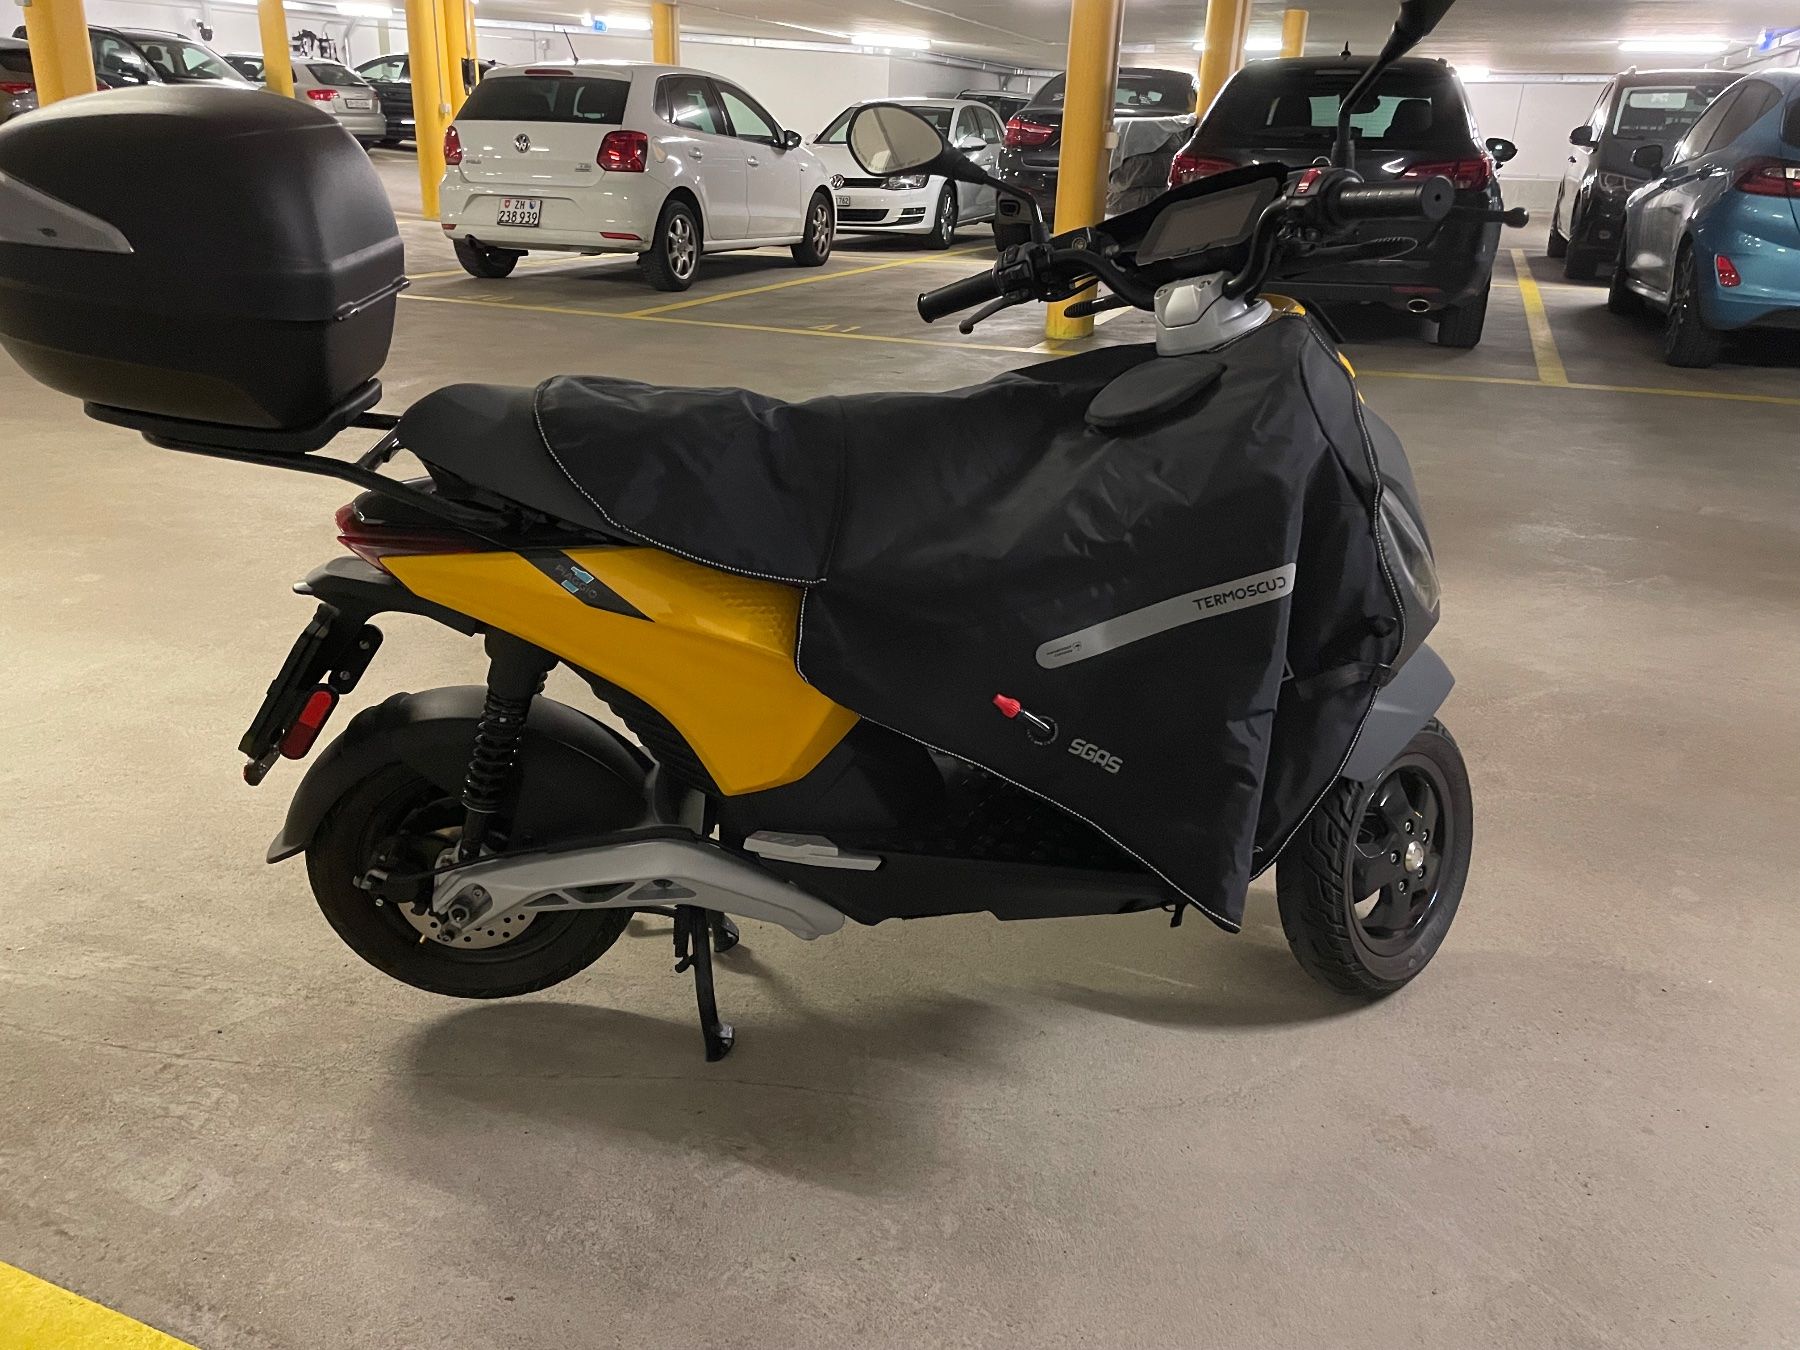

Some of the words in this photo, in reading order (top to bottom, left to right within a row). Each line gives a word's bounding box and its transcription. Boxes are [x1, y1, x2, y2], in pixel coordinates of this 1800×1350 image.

[514, 200, 526, 209] ZH
[555, 563, 598, 600] PIAGGIO
[1192, 576, 1286, 610] TERMOSCUD
